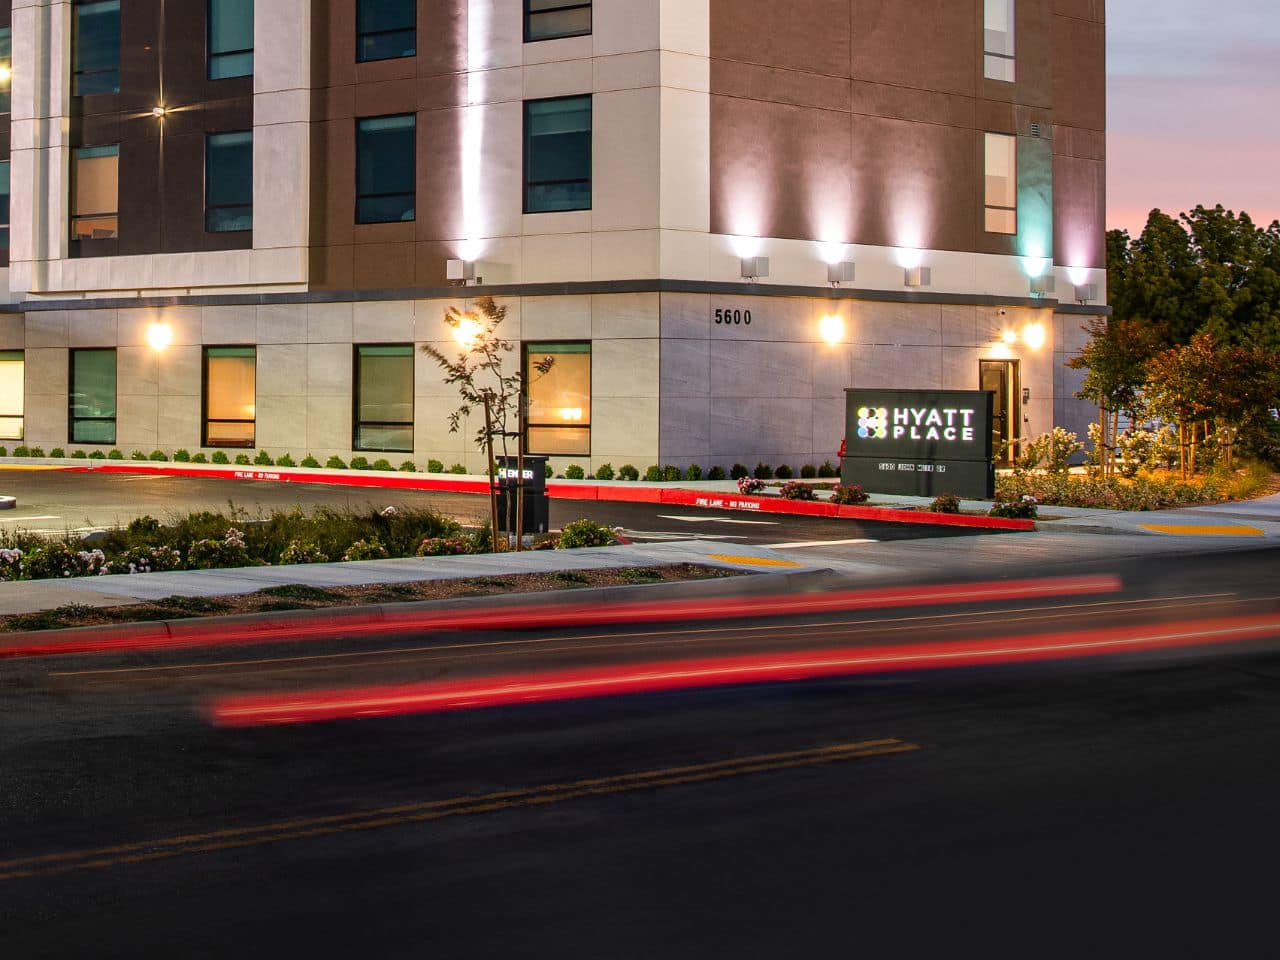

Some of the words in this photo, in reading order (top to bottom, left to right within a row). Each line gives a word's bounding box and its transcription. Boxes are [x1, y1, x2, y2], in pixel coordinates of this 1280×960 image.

[715, 308, 752, 325] 5600
[893, 407, 975, 427] HYATT
[893, 426, 975, 441] PLACE
[507, 469, 534, 480] ENER
[696, 497, 708, 507] FIRE
